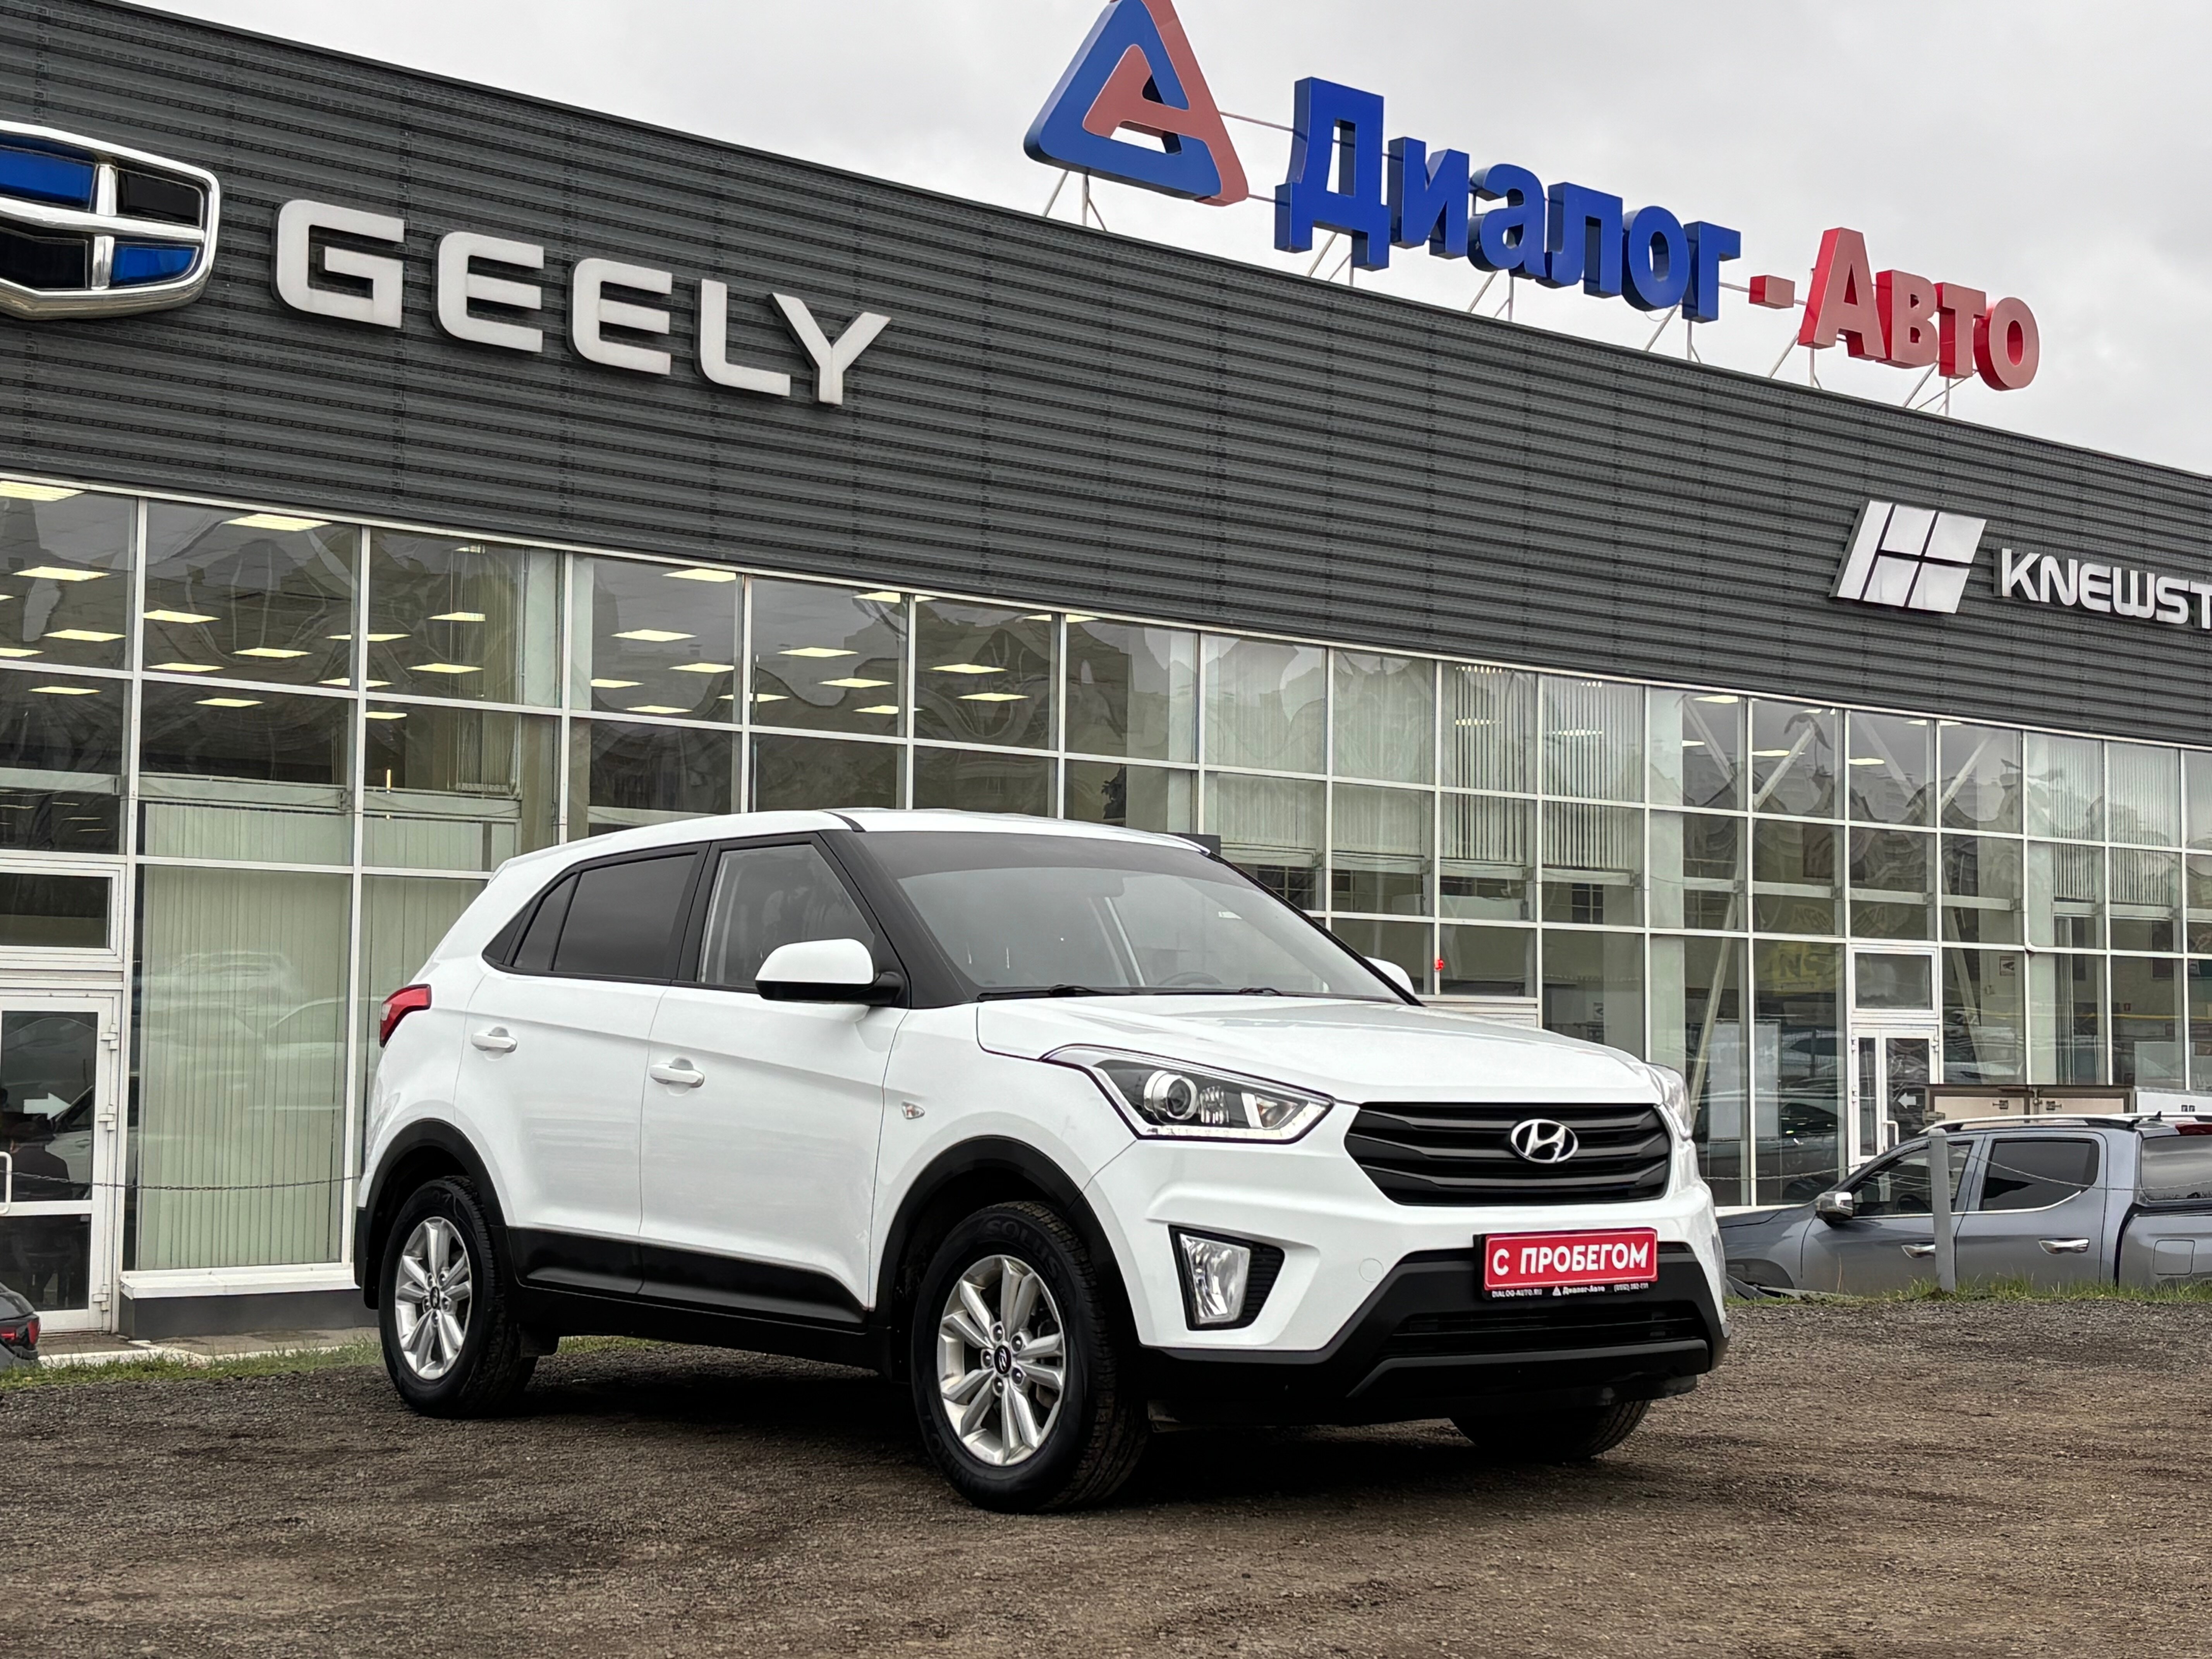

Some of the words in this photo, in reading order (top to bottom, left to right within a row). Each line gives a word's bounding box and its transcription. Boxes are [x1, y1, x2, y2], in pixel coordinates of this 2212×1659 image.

[1273, 76, 2040, 392] Диалог-Авто
[273, 199, 892, 406] GEELY
[986, 1219, 1061, 1279] SOLUS
[1492, 1248, 1510, 1276] С
[1520, 1242, 1649, 1274] ПРОБЕГОМ
